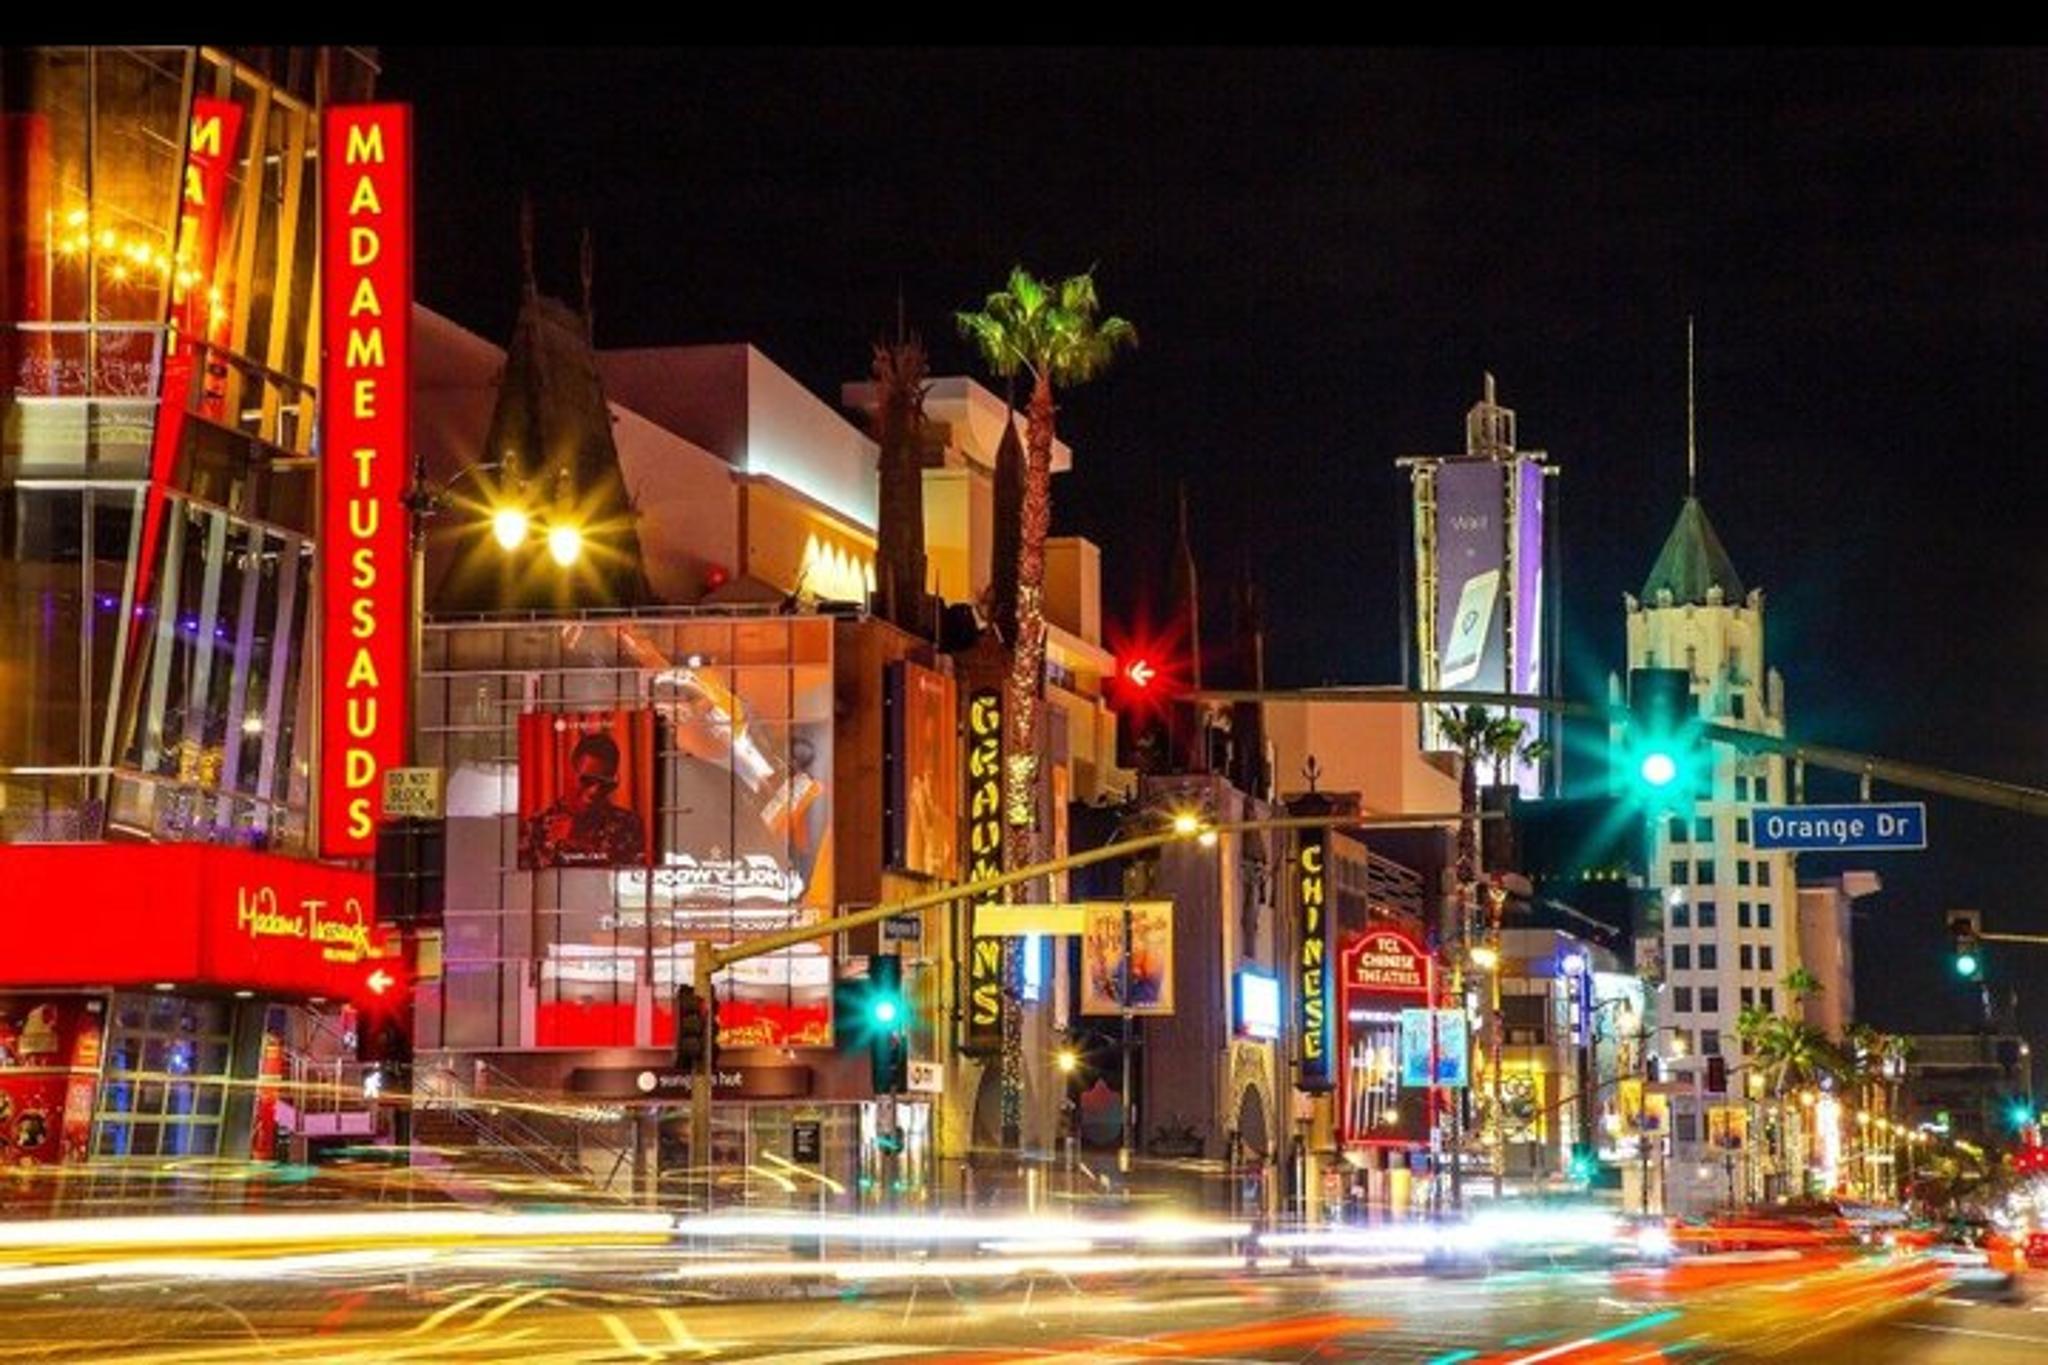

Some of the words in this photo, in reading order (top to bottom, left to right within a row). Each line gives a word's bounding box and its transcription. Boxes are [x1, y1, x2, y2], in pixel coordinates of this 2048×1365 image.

[345, 124, 385, 418] MADAME
[345, 449, 381, 840] TUSSAUDS
[1768, 815, 1865, 844] Orange
[1877, 812, 1909, 837] Dr
[1301, 844, 1323, 1059] CHINESE
[1361, 952, 1416, 971] CHINESE
[1377, 937, 1401, 954] TCL
[1357, 968, 1420, 986] THEATRES
